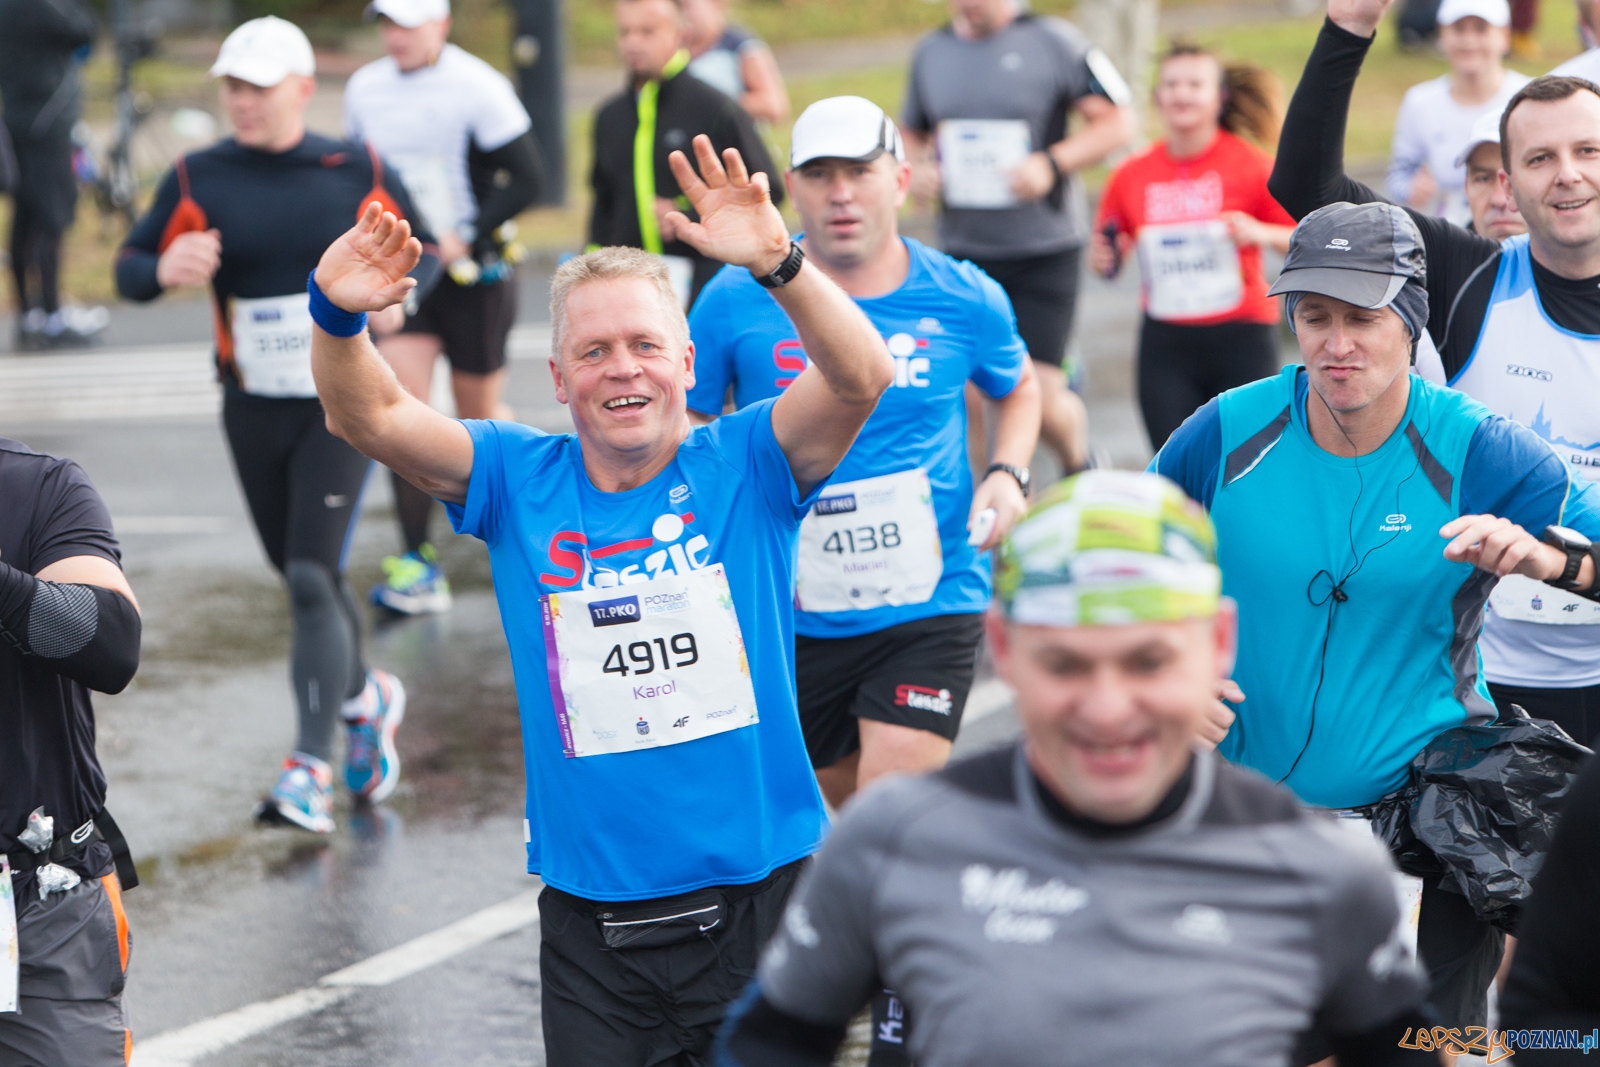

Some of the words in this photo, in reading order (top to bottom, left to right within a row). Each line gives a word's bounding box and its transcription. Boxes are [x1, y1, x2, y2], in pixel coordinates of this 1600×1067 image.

[822, 522, 901, 554] 4138
[593, 602, 637, 619] 17.PKO
[602, 632, 699, 677] 4919
[633, 680, 677, 700] Karol
